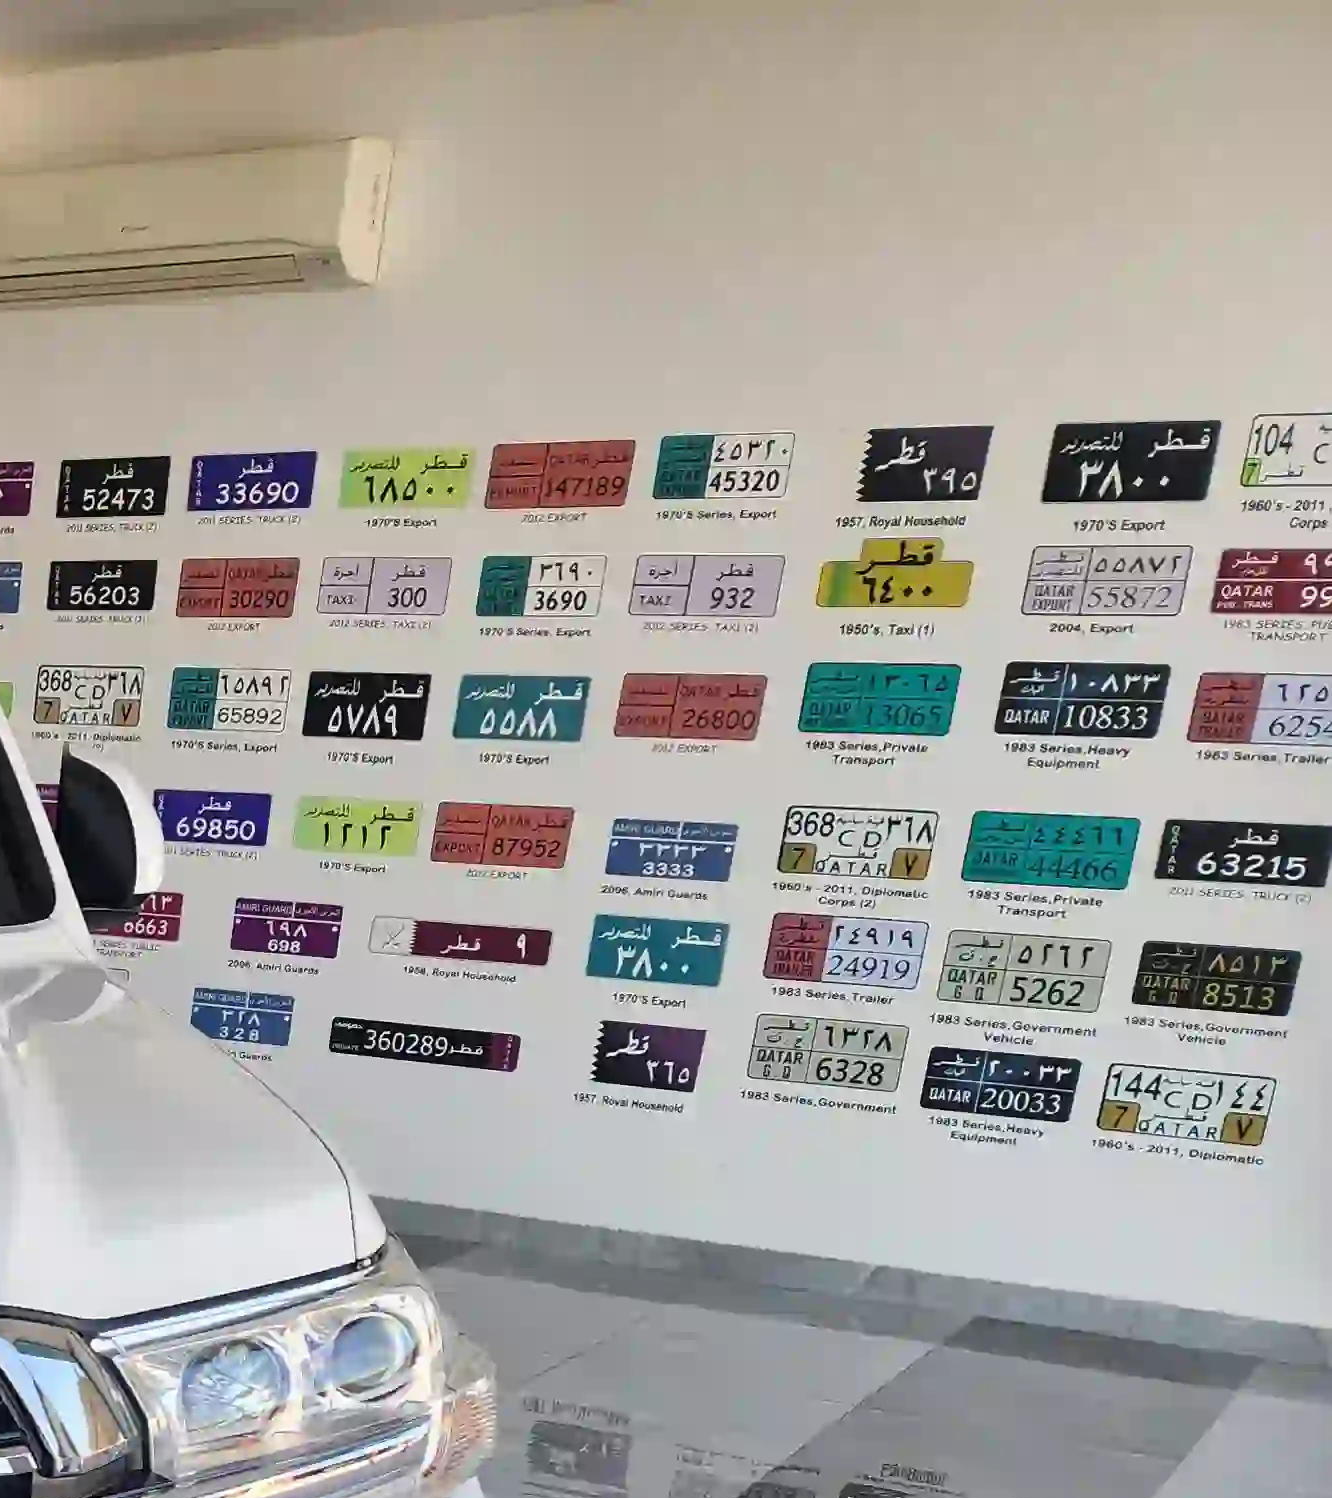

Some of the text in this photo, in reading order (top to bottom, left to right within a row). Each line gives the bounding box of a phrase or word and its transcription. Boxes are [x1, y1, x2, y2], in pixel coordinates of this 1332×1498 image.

[1147, 428, 1212, 459] قطر
[1255, 423, 1295, 456] 104
[714, 440, 788, 462] ٤٥٣٢٠
[875, 436, 928, 473] قطر
[102, 461, 134, 484] قطر
[236, 459, 274, 480] قطر
[420, 454, 468, 474] قطر
[1247, 462, 1257, 484] 7
[545, 477, 624, 498] 147189
[708, 470, 779, 493] 45320
[923, 467, 976, 495] ٣٩٥
[1079, 459, 1171, 499] ٣٨٠٠
[82, 487, 155, 512] 52473
[216, 482, 299, 504] 33690
[364, 477, 455, 503] ٦٨٥٠٠
[740, 510, 777, 521] Export
[869, 516, 966, 529] Royal Household
[1121, 519, 1166, 533] Export
[1289, 518, 1328, 530] Corps
[855, 540, 935, 575] قطر
[1094, 554, 1182, 576] ٥٥٨٧٢
[1232, 552, 1279, 569] قطر
[92, 565, 123, 583] قطر
[392, 565, 426, 581] قطر
[539, 562, 593, 581] ٣٦٩٠
[715, 563, 754, 581] قطر
[69, 586, 141, 605] 56203
[229, 589, 289, 609] 30290
[387, 587, 427, 608] 300
[534, 590, 587, 611] 3690
[639, 595, 672, 606] TAXI
[710, 587, 755, 609] 932
[863, 576, 933, 604] ٦٤٠٠
[1087, 586, 1173, 609] 55872
[1220, 585, 1274, 599] QATAR
[889, 624, 916, 635] Taxi
[1049, 622, 1134, 635] 2004, Export
[1250, 631, 1328, 642] TRANSPORT
[39, 670, 72, 691] 368
[220, 674, 288, 696] ٦٥٨٩٢
[1070, 672, 1161, 693] ١٠٨٣٣
[378, 680, 424, 703] قطر
[534, 680, 583, 705] قطر
[44, 701, 53, 720] 7
[60, 711, 110, 724] QATAR
[217, 707, 282, 725] 65892
[327, 703, 398, 736] ٥٧٨٩
[682, 708, 755, 730] 26800
[863, 704, 944, 727] 13065
[1004, 709, 1049, 725] QATAR
[1063, 705, 1149, 731] 10833
[480, 708, 556, 739] ٥٥٨٨
[832, 755, 895, 767] Transport
[1027, 758, 1100, 770] Equipment
[198, 796, 232, 814] قطر
[370, 806, 415, 824] قطر
[176, 818, 255, 840] 69850
[788, 811, 835, 836] 368
[886, 816, 933, 843] ٣٦٨
[323, 822, 391, 850] ١٢١٢
[1034, 827, 1123, 844] ٤٤٤٦٦
[1228, 829, 1281, 849] قطر
[491, 839, 561, 858] 87952
[639, 842, 707, 859] ٣٣٣٣
[1168, 824, 1180, 875] QATAR
[642, 862, 695, 877] 3333
[792, 849, 806, 870] 7
[816, 861, 888, 877] QATAR
[1027, 856, 1117, 881] 44466
[1197, 851, 1309, 880] 63215
[635, 887, 708, 900] Amiri Guards
[818, 896, 876, 909] Corps (2)
[861, 885, 928, 899] Diplomatic
[968, 889, 1000, 901] 1983
[998, 904, 1067, 919] Transport
[266, 921, 308, 939] ٦٩٨
[670, 926, 722, 948] قطر
[835, 924, 914, 948] ٢٤٩١٩
[268, 940, 301, 953] 698
[440, 932, 481, 954] قطر
[517, 933, 526, 958] ٩
[616, 944, 690, 979] ٣٨٠٠
[1017, 943, 1094, 969] ٥٢٦٢
[1208, 953, 1289, 977] ٨٥١٣
[827, 955, 911, 980] 24919
[947, 969, 997, 985] QATAR
[771, 986, 802, 997] 1983
[1010, 976, 1084, 1007] 5262
[1143, 976, 1189, 991] QATAR
[651, 996, 686, 1008] Export
[1203, 982, 1276, 1011] 8513
[222, 1010, 261, 1027] ٣٢٨
[929, 1013, 961, 1025] 1983
[1124, 1015, 1154, 1027] 1983
[220, 1027, 259, 1040] 328
[364, 1029, 448, 1057] 360289
[604, 1029, 650, 1059] قطر
[825, 1025, 892, 1053] ٦٣٢٨
[983, 1032, 1034, 1046] Vehicle
[1175, 1033, 1226, 1046] Vehicle
[448, 1043, 484, 1055] قطر
[756, 1049, 804, 1065] QATAR
[646, 1059, 690, 1084] ٣٦٥
[816, 1058, 884, 1086] 6328
[987, 1060, 1072, 1083] ٢٠٠٣٣
[740, 1090, 770, 1100] 1983
[1111, 1069, 1162, 1100] 144
[601, 1095, 684, 1113] Royal Household
[929, 1087, 970, 1104] QATAR
[980, 1087, 1060, 1115] 20033
[1216, 1080, 1268, 1111] ١٤٤
[1114, 1106, 1130, 1129] 7
[951, 1130, 1017, 1146] Equipment
[1138, 1120, 1218, 1139] QATAR
[1236, 1120, 1253, 1140] ٧
[1146, 1143, 1265, 1166] 2011, Diplomatic
